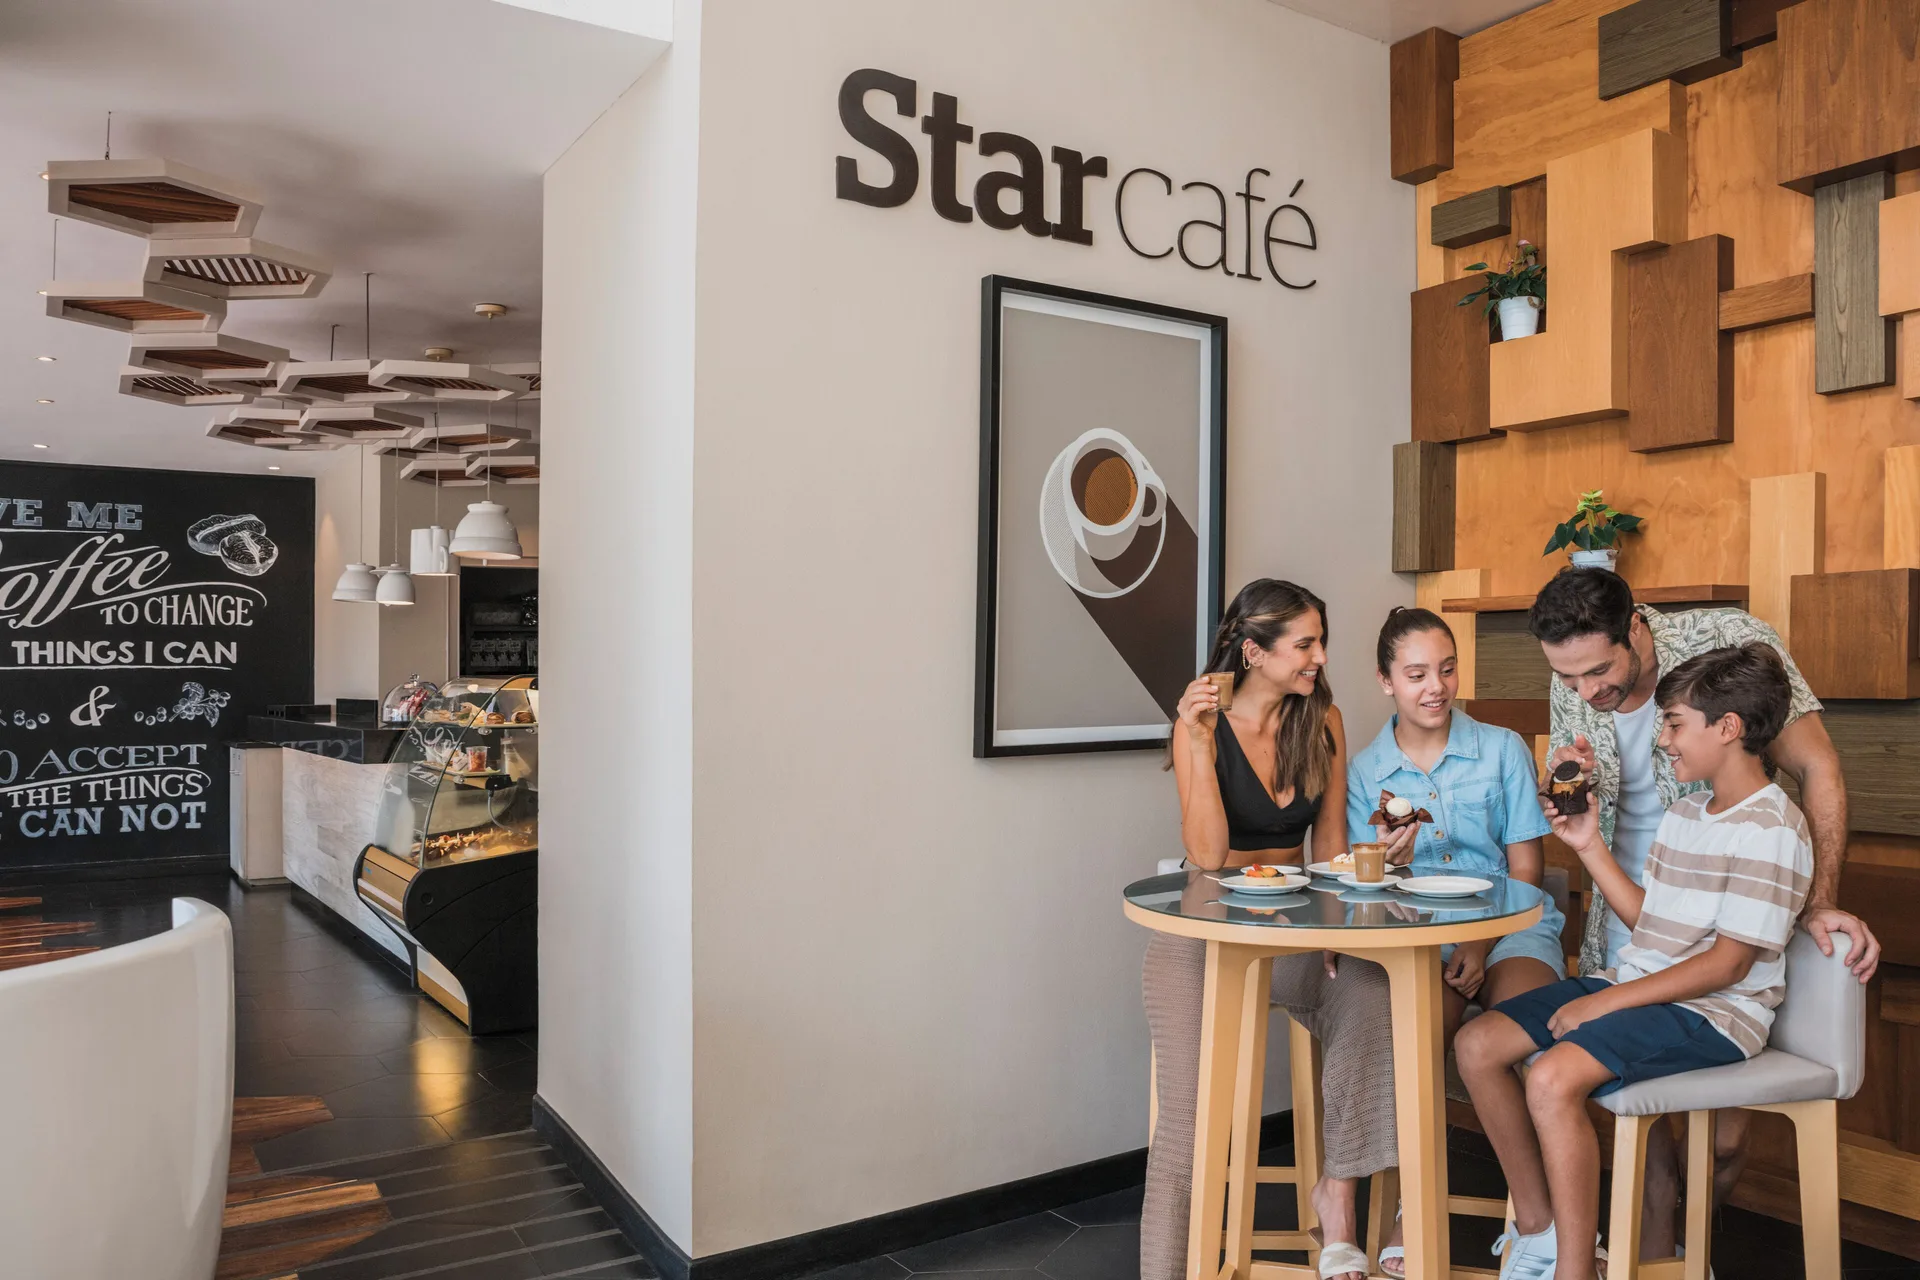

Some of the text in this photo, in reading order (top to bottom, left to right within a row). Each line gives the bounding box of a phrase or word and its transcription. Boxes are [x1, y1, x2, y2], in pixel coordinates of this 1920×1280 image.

[67, 501, 142, 531] ME
[0, 533, 171, 629] offee
[100, 594, 254, 626] TO CHANGE
[11, 640, 237, 665] THINGS I CAN
[70, 685, 117, 727] &
[25, 744, 207, 780] ACCEPT
[7, 774, 204, 808] THE THINGS
[19, 807, 104, 838] CAN
[119, 801, 207, 833] NOT
